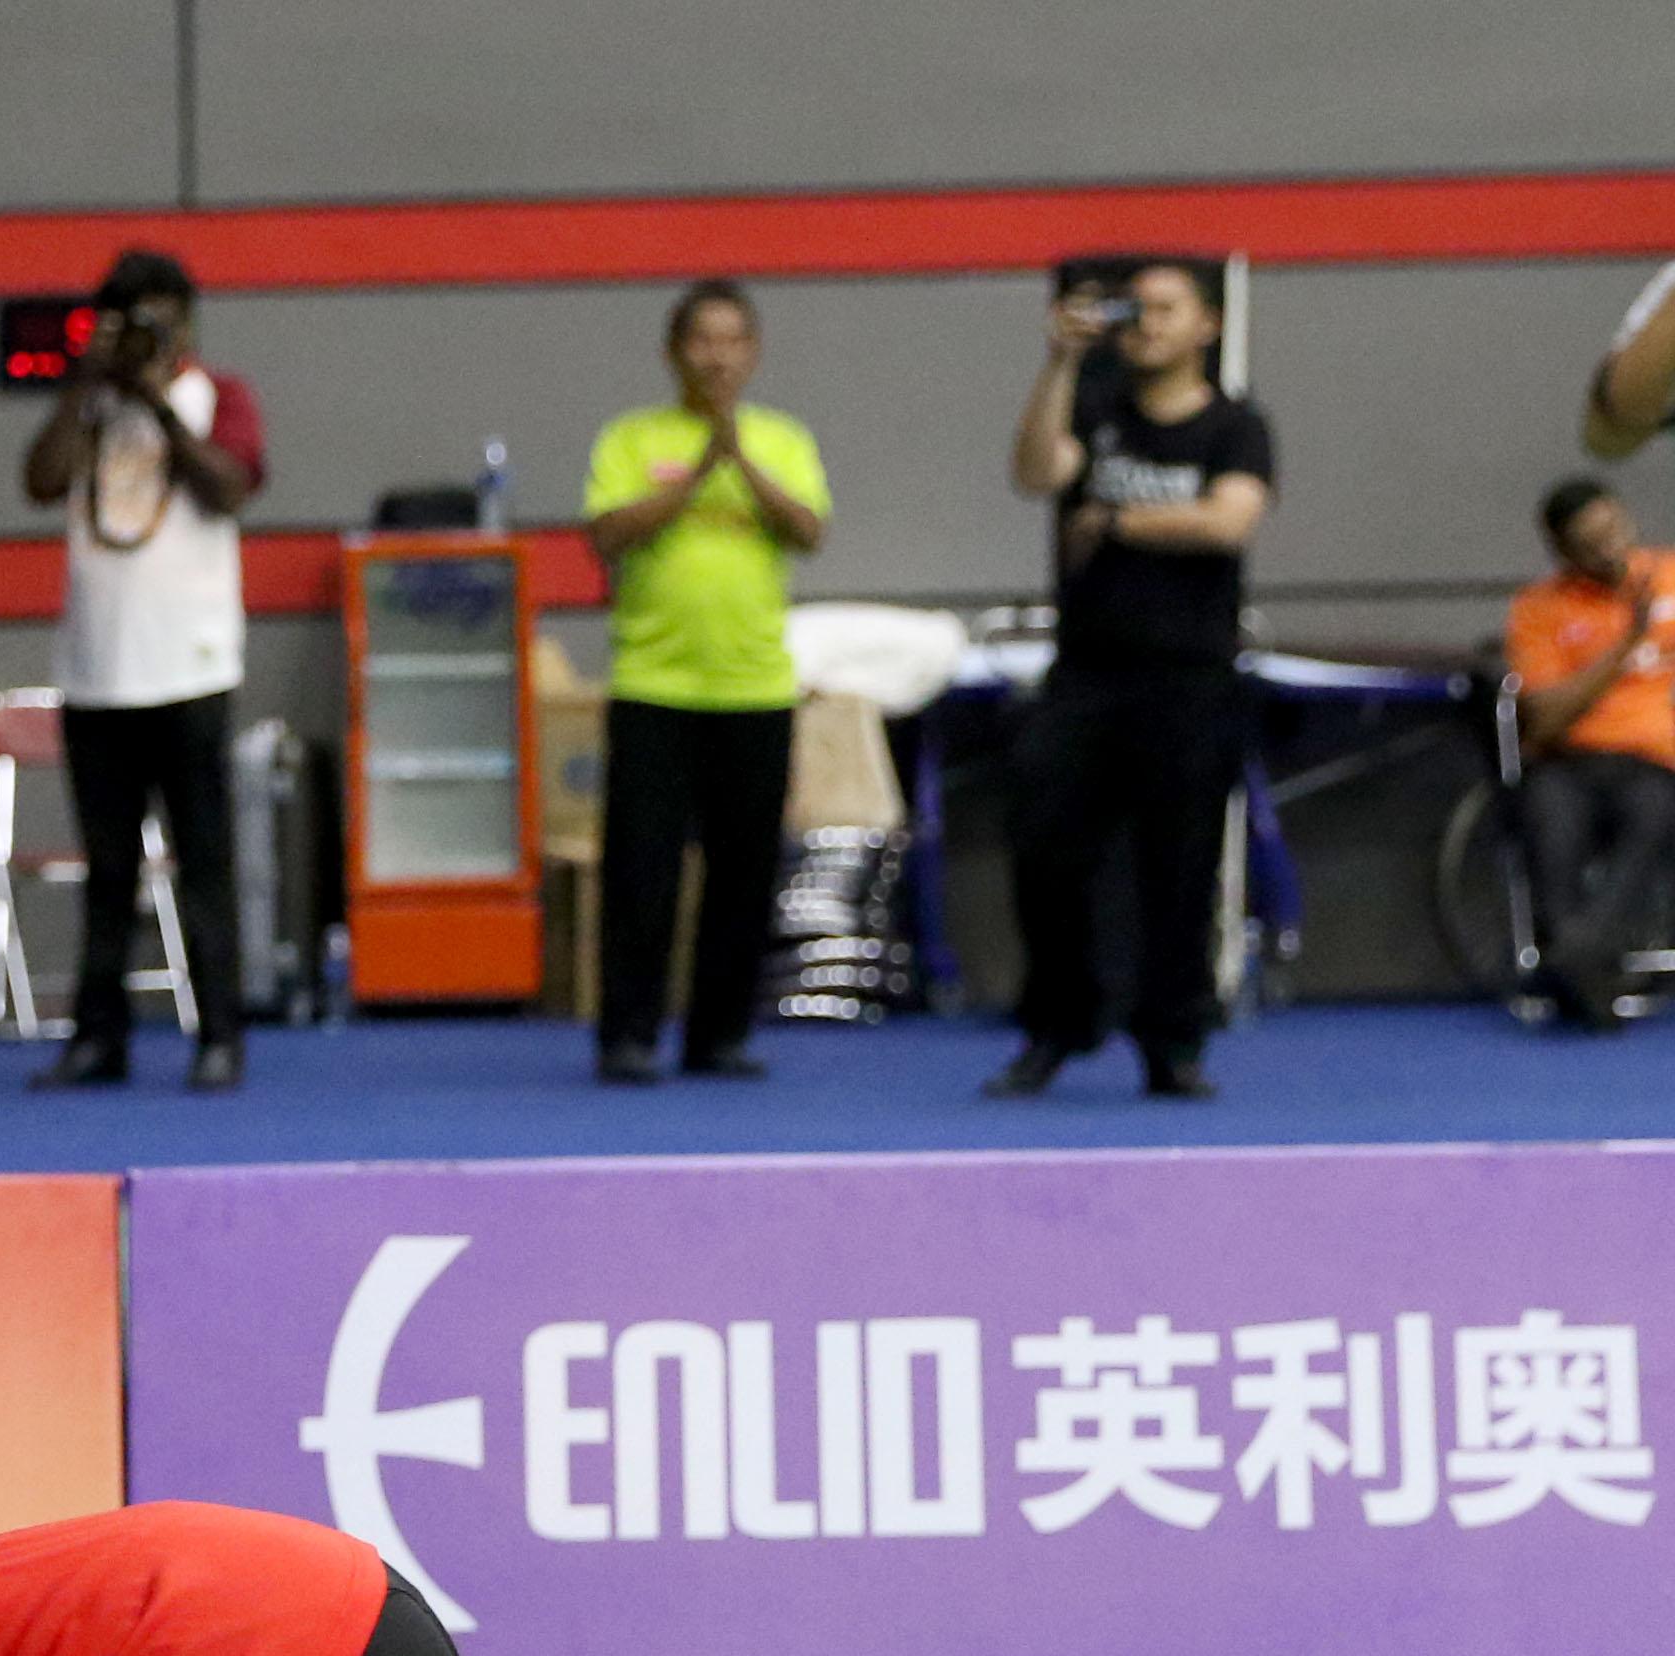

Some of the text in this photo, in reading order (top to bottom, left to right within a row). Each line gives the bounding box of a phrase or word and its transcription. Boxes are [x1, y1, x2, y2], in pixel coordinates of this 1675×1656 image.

[521, 1308, 1655, 1541] ENLIO 英利奥
